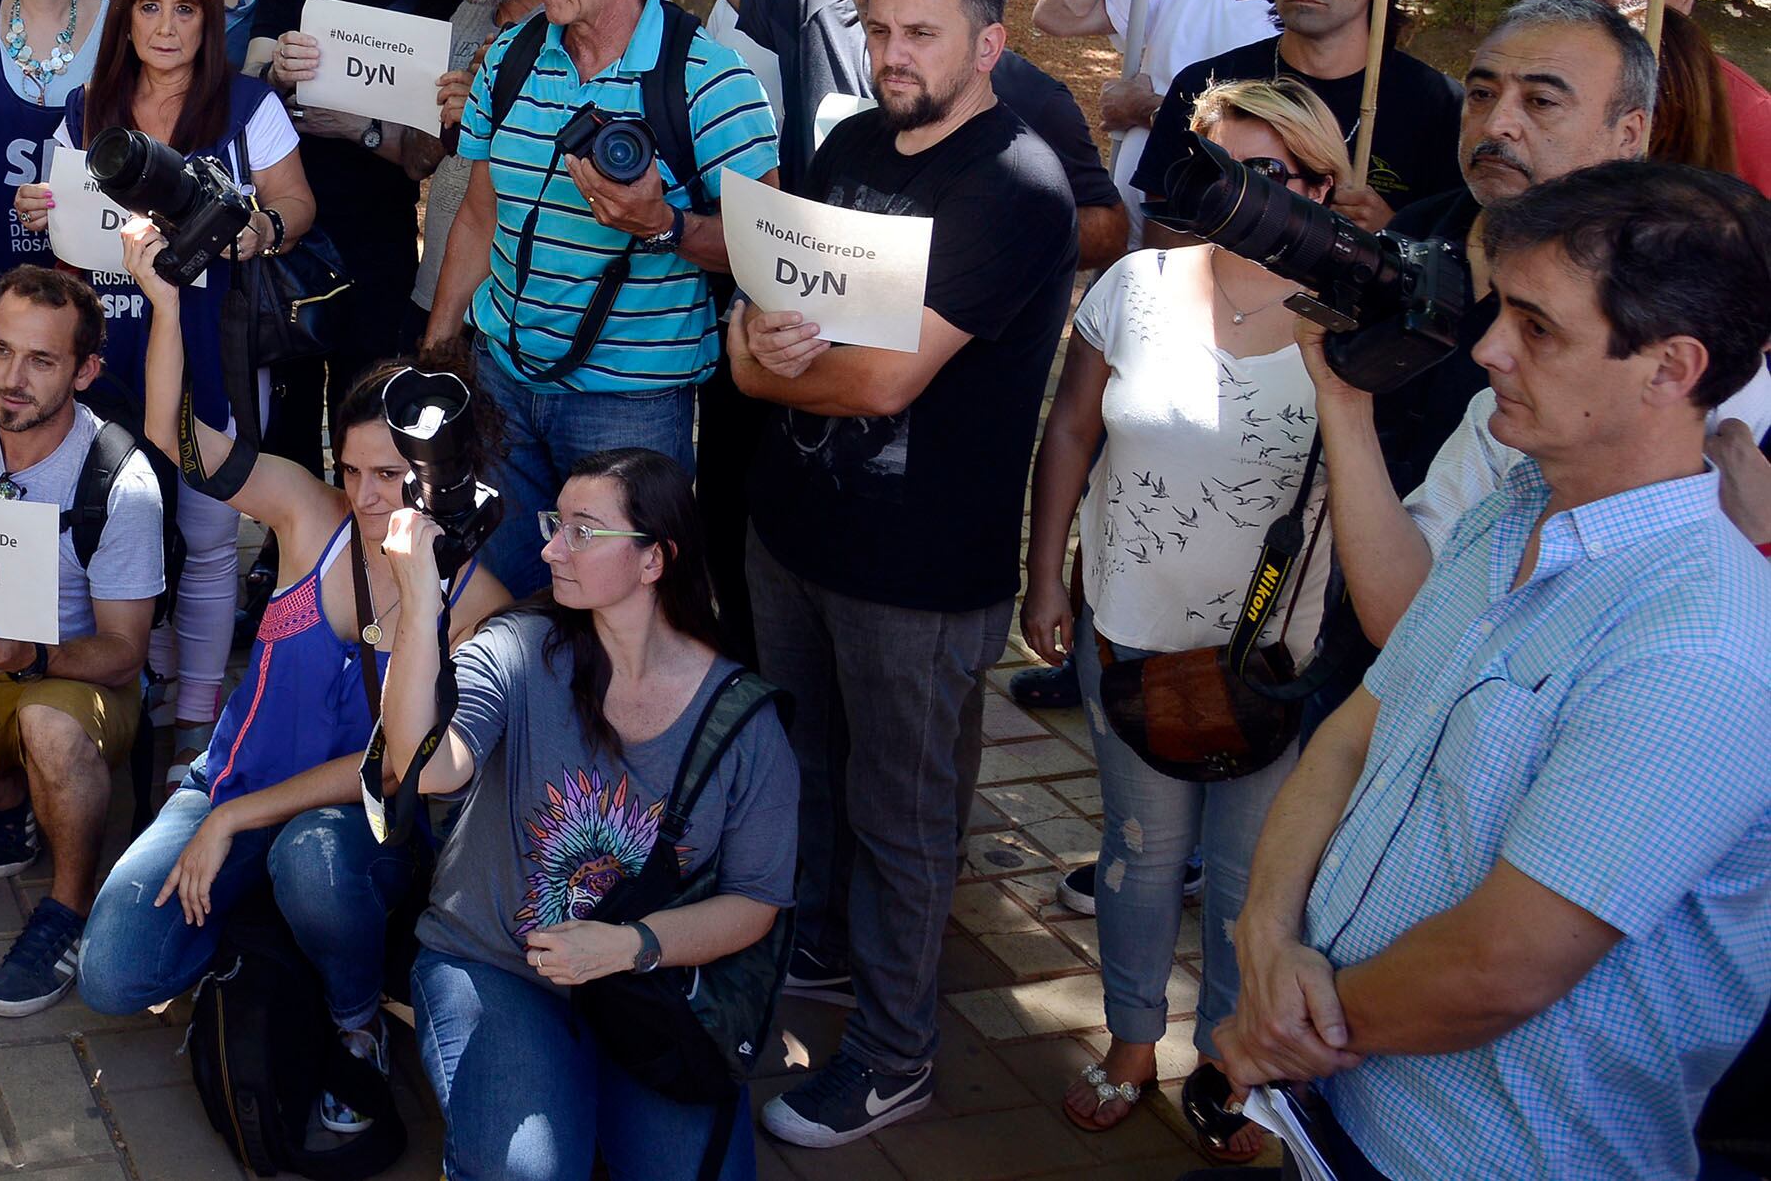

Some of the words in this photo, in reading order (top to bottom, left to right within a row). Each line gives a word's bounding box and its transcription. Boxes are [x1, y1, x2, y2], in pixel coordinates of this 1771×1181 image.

[330, 29, 414, 55] #NoAlCierreDe
[346, 56, 395, 86] DyN
[756, 218, 876, 260] #NoAlCierreDe
[775, 257, 848, 297] DyN
[102, 293, 144, 319] SPR
[1248, 563, 1279, 622] Nikon
